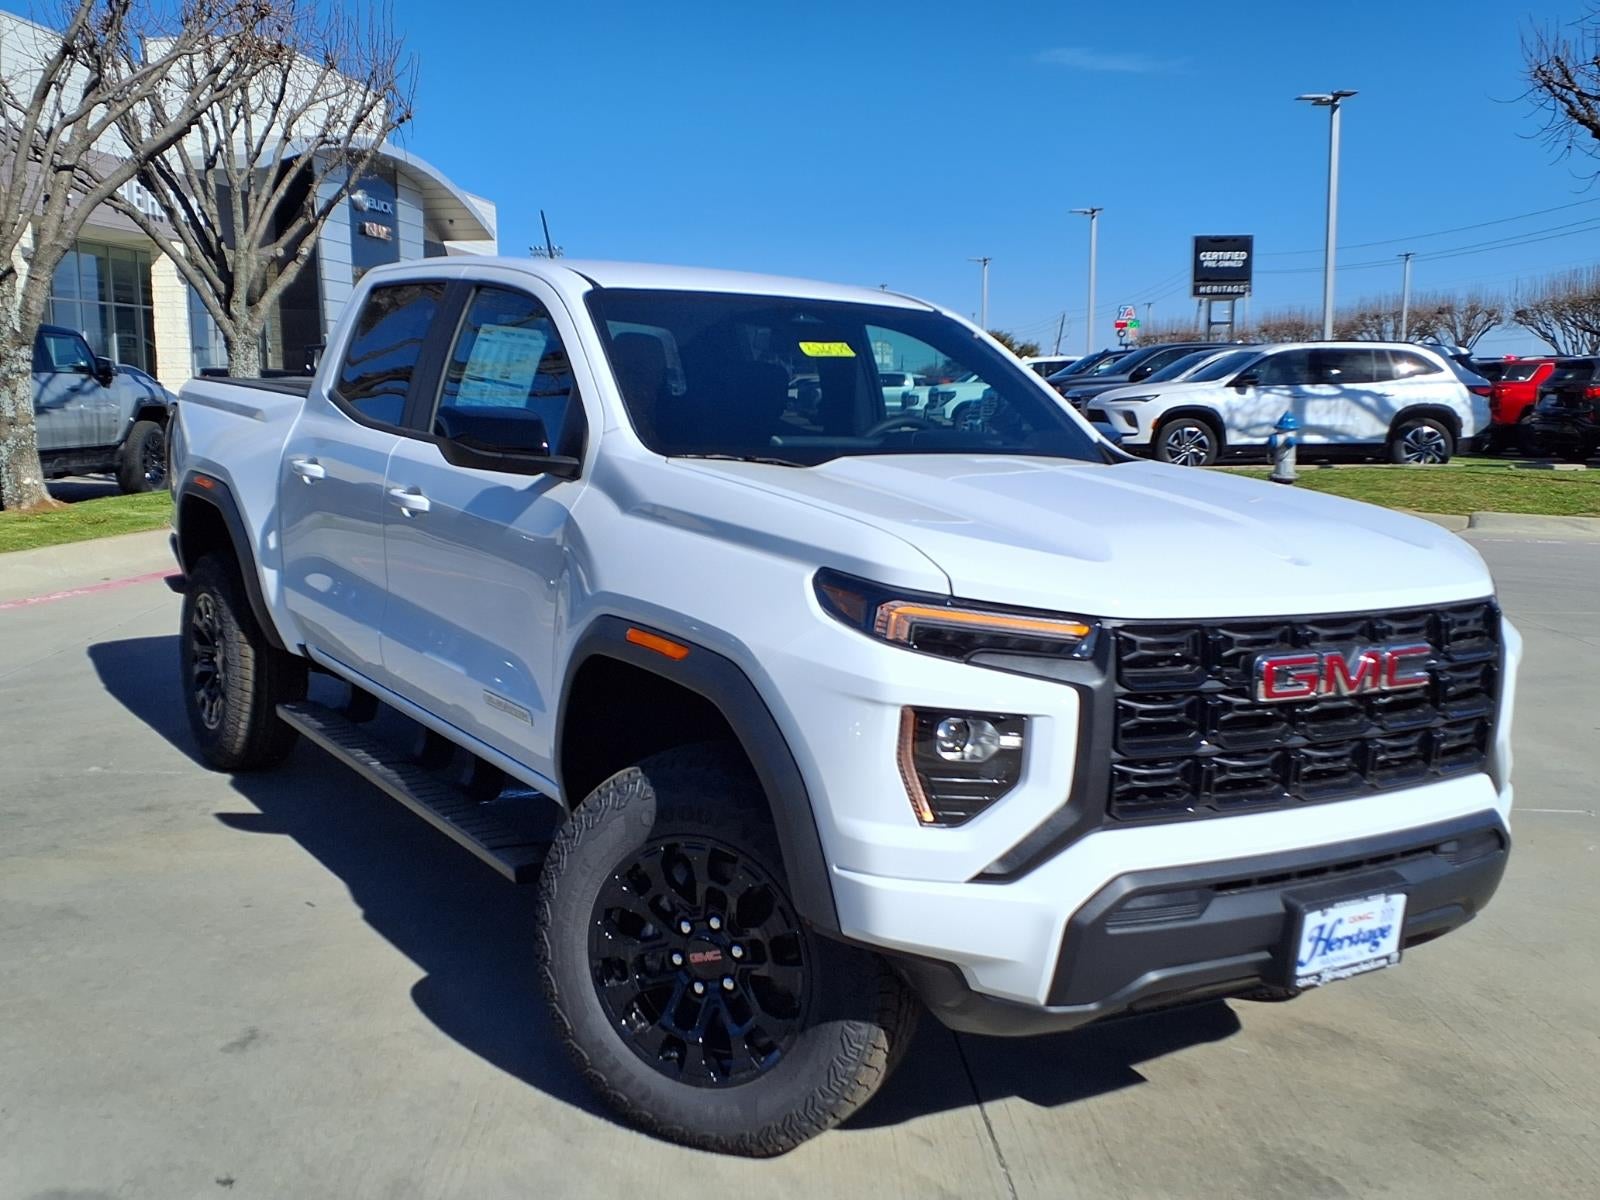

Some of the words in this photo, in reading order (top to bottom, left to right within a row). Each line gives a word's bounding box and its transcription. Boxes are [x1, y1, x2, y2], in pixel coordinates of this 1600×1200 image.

[368, 198, 393, 214] BUICK
[1199, 251, 1248, 261] CERTIFIED
[1203, 260, 1244, 268] PRE-OWNED
[1199, 285, 1245, 293] HERITAGE
[1254, 641, 1431, 703] GMC
[1296, 917, 1392, 968] Heritage
[689, 949, 722, 964] GMC
